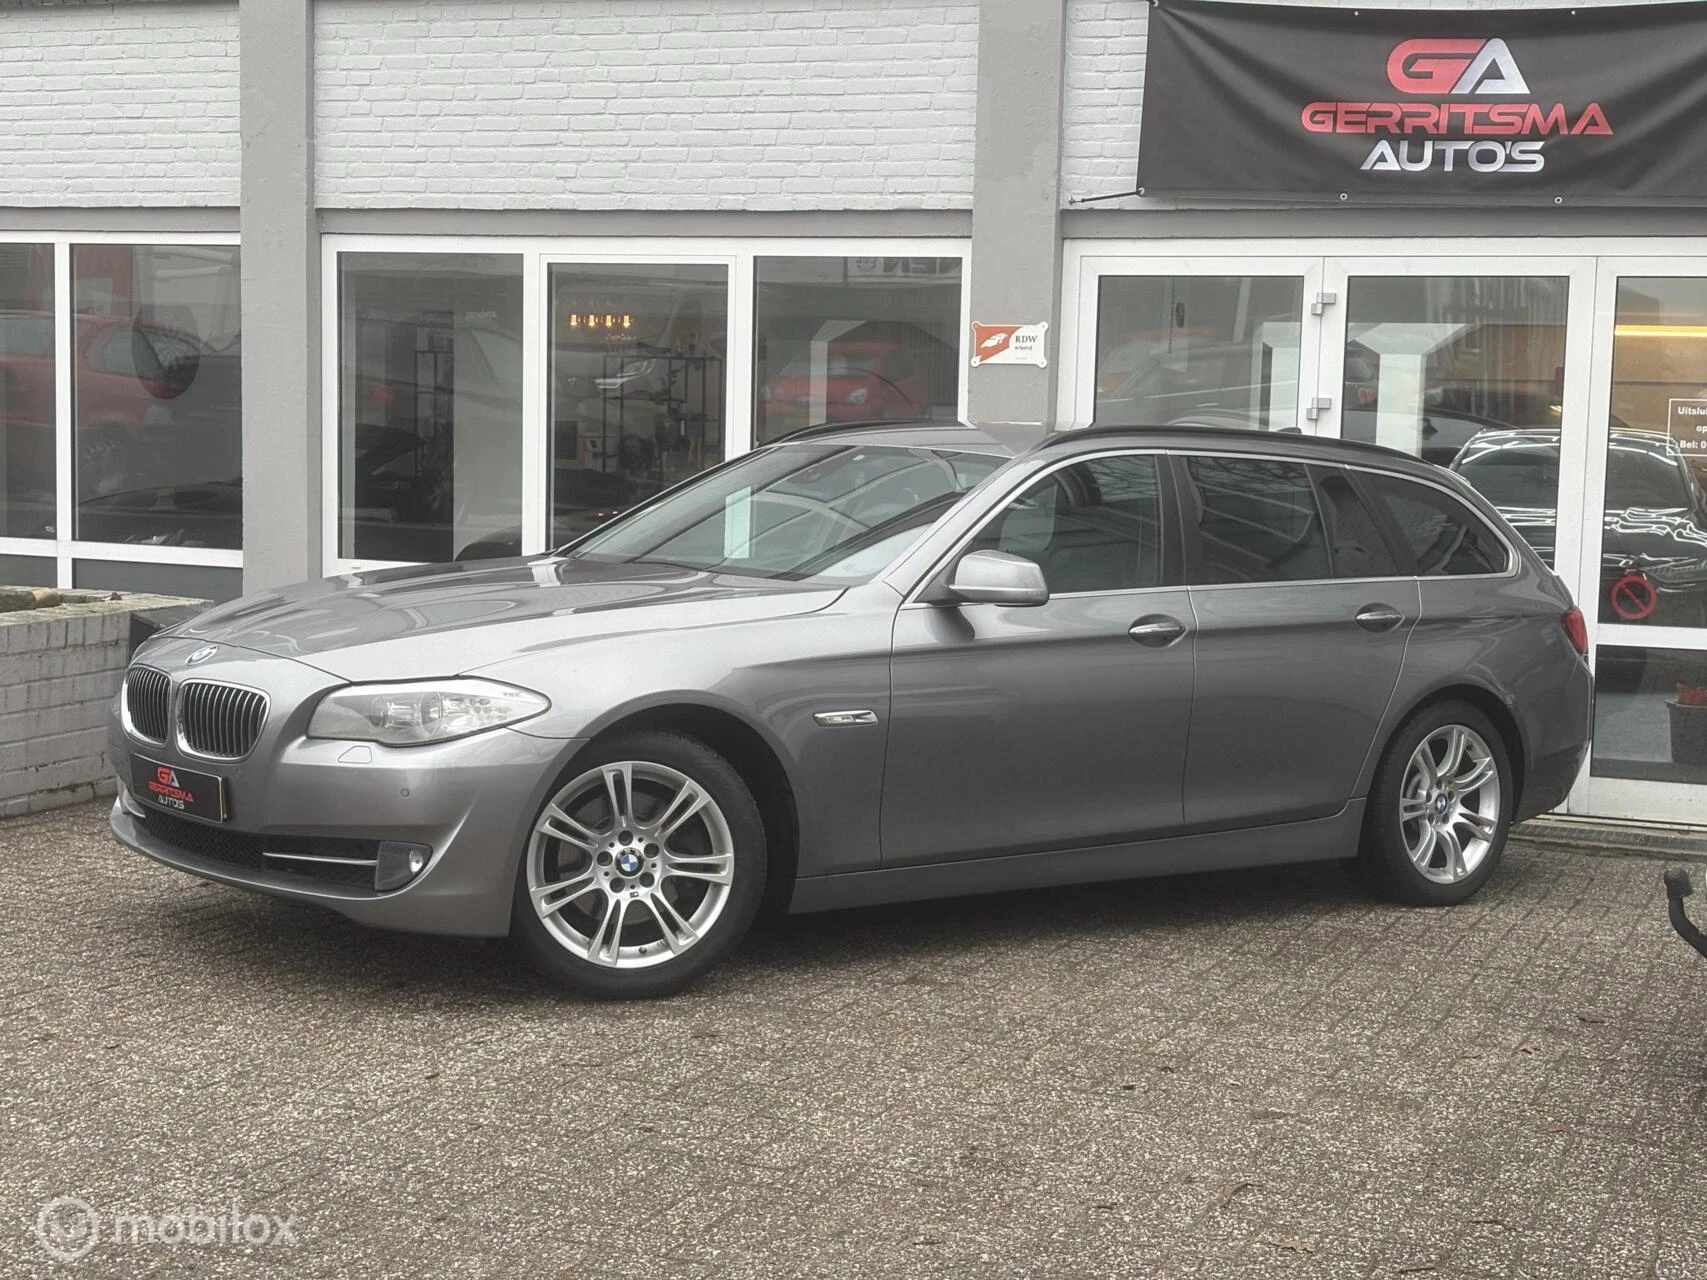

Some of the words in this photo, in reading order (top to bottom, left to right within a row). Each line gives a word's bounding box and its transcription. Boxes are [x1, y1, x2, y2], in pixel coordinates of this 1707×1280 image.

[1387, 37, 1531, 94] GA
[1301, 102, 1614, 135] GERRITSMA
[1360, 139, 1545, 173] AUTO'S
[1015, 335, 1038, 343] RDW
[1679, 440, 1699, 449] Bel:
[157, 766, 180, 787] GA
